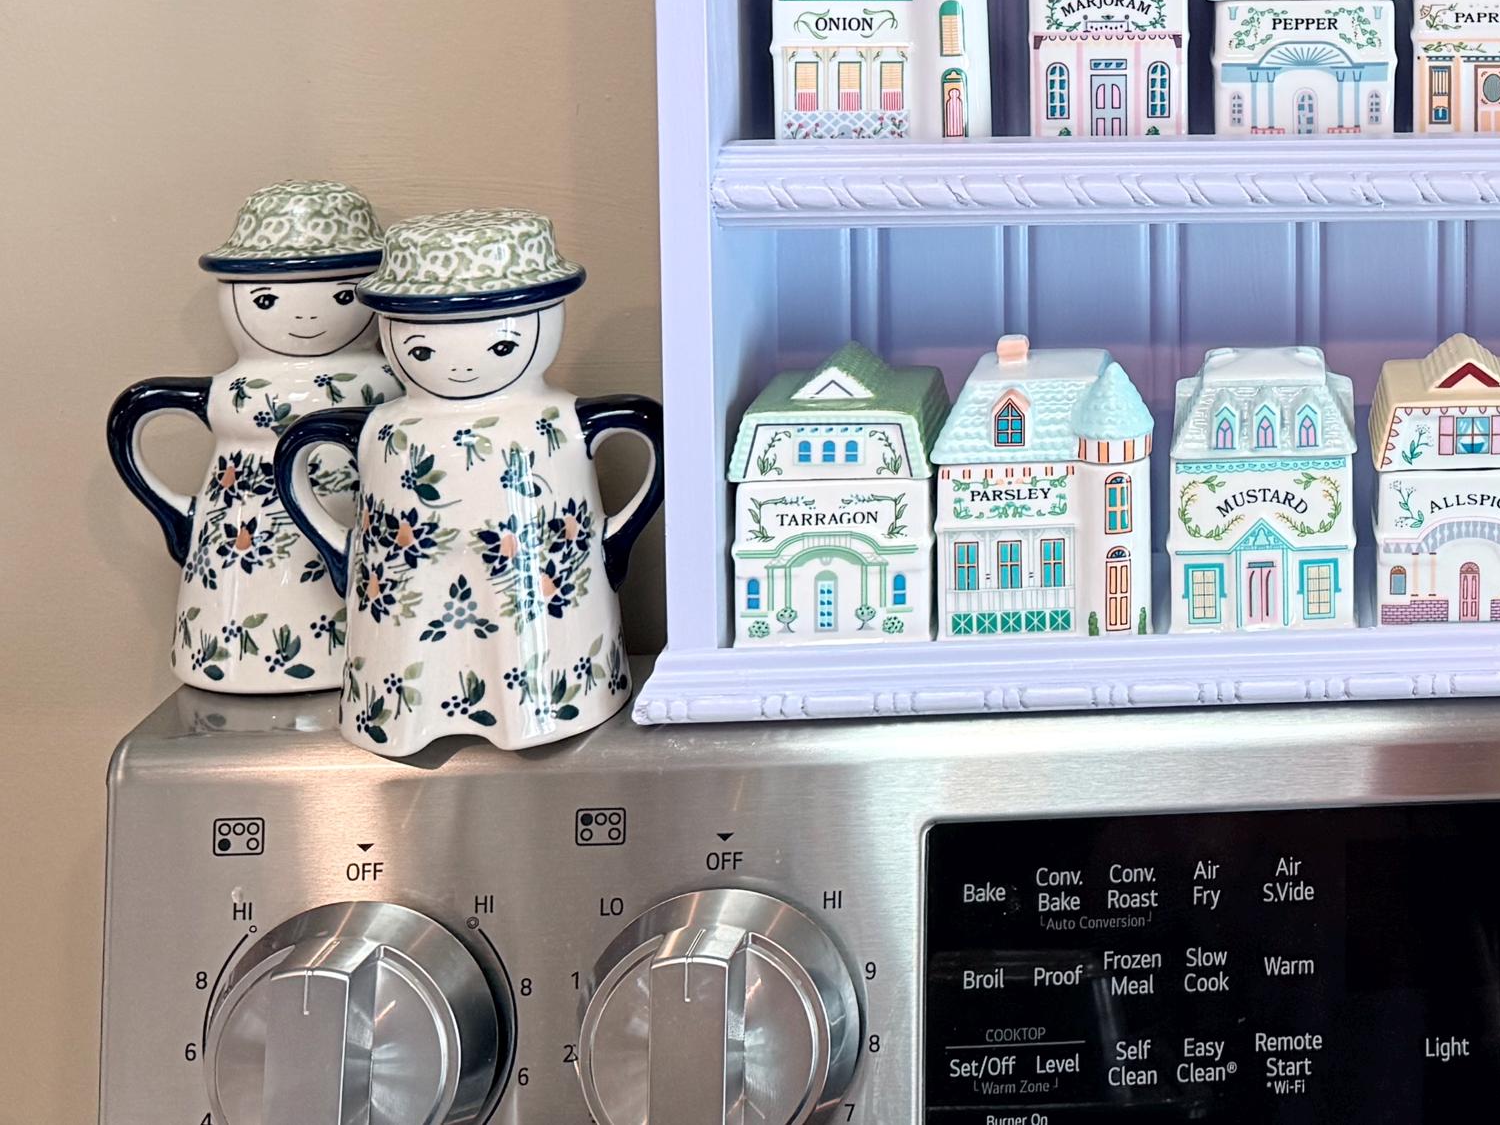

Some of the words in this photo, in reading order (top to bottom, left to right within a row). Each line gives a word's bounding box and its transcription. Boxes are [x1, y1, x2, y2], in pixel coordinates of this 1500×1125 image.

[814, 15, 874, 32] ONION
[1271, 15, 1338, 33] PEPPER
[970, 486, 1052, 506] PARSLEY
[1216, 488, 1310, 519] MUSTARD
[775, 509, 880, 529] TARRAGON
[707, 852, 742, 870] OFF
[1194, 861, 1219, 879] Air
[1276, 857, 1301, 876] Air
[347, 862, 384, 881] OFF
[1036, 868, 1082, 886] Conv.
[1110, 864, 1155, 883] Conv.
[824, 891, 841, 909] HI
[964, 882, 1005, 902] Bake
[1108, 890, 1158, 908] Roast
[1194, 886, 1220, 910] Fry
[1264, 881, 1314, 902] S.Vide
[475, 895, 493, 913] HI
[601, 898, 623, 916] LO
[1039, 892, 1080, 911] Bake
[233, 902, 252, 920] HI
[1047, 918, 1075, 930] Auto
[1080, 916, 1145, 929] Conversion
[1104, 951, 1161, 970] Frozen
[1187, 947, 1227, 966] Slow
[866, 962, 876, 980] 9
[1264, 957, 1314, 975] Warm
[196, 972, 207, 989] 8
[571, 971, 578, 989] 1
[964, 968, 1004, 989] Broil
[1035, 965, 1083, 986] Proof
[1185, 971, 1229, 992] Cook
[521, 978, 531, 996] 8
[1112, 975, 1153, 995] Meal
[869, 1035, 880, 1052] 8
[986, 1027, 1048, 1044] COOKTOP
[1256, 1033, 1322, 1051] Remote
[185, 1043, 196, 1061] 6
[563, 1044, 577, 1062] 2
[1116, 1040, 1151, 1060] Self
[1184, 1038, 1224, 1061] Easy
[1426, 1037, 1469, 1061] Light
[950, 1056, 1016, 1078] Set/Off
[1037, 1053, 1079, 1073] Level
[1267, 1058, 1311, 1076] Start
[518, 1068, 528, 1086] 6
[1109, 1066, 1157, 1086] Clean
[982, 1082, 1015, 1094] Warm
[1020, 1080, 1049, 1093] Zone
[845, 1104, 855, 1122] 7
